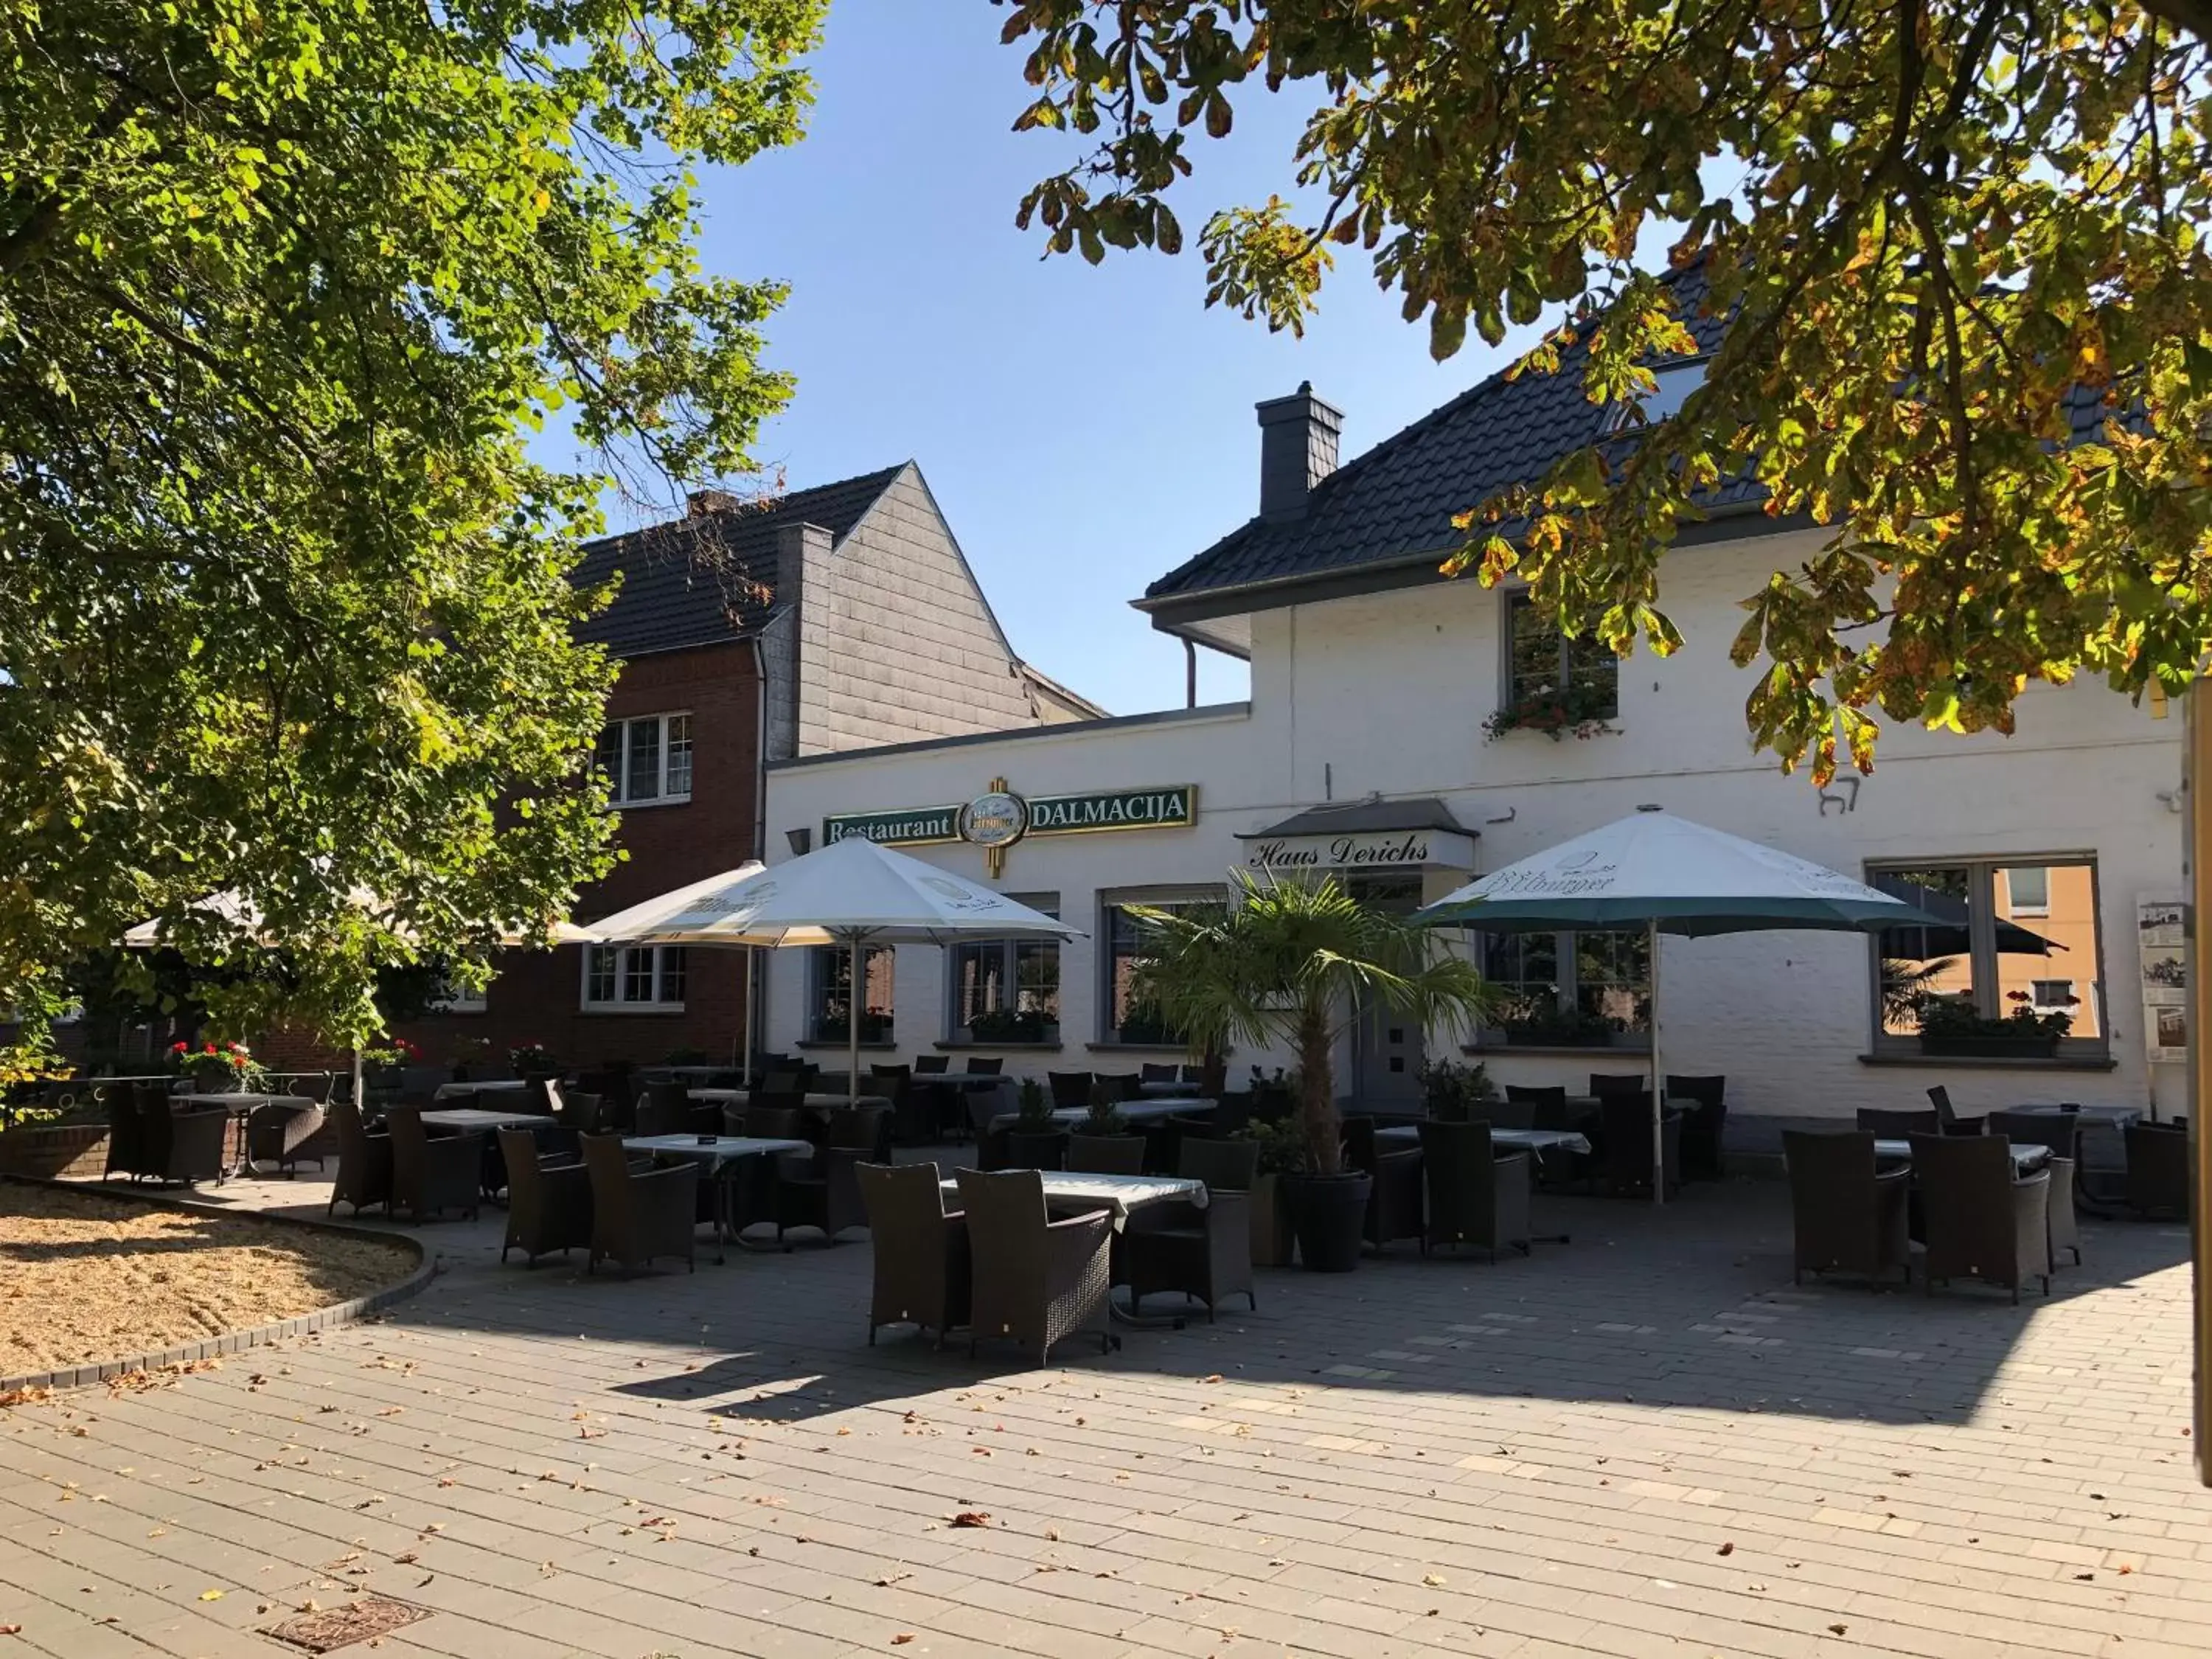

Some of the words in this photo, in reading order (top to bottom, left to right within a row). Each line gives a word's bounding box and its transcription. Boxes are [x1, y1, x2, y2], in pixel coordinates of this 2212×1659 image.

[1032, 793, 1185, 827] DALMACIJA
[1250, 841, 1318, 868] Haus
[1330, 835, 1428, 864] Derichs
